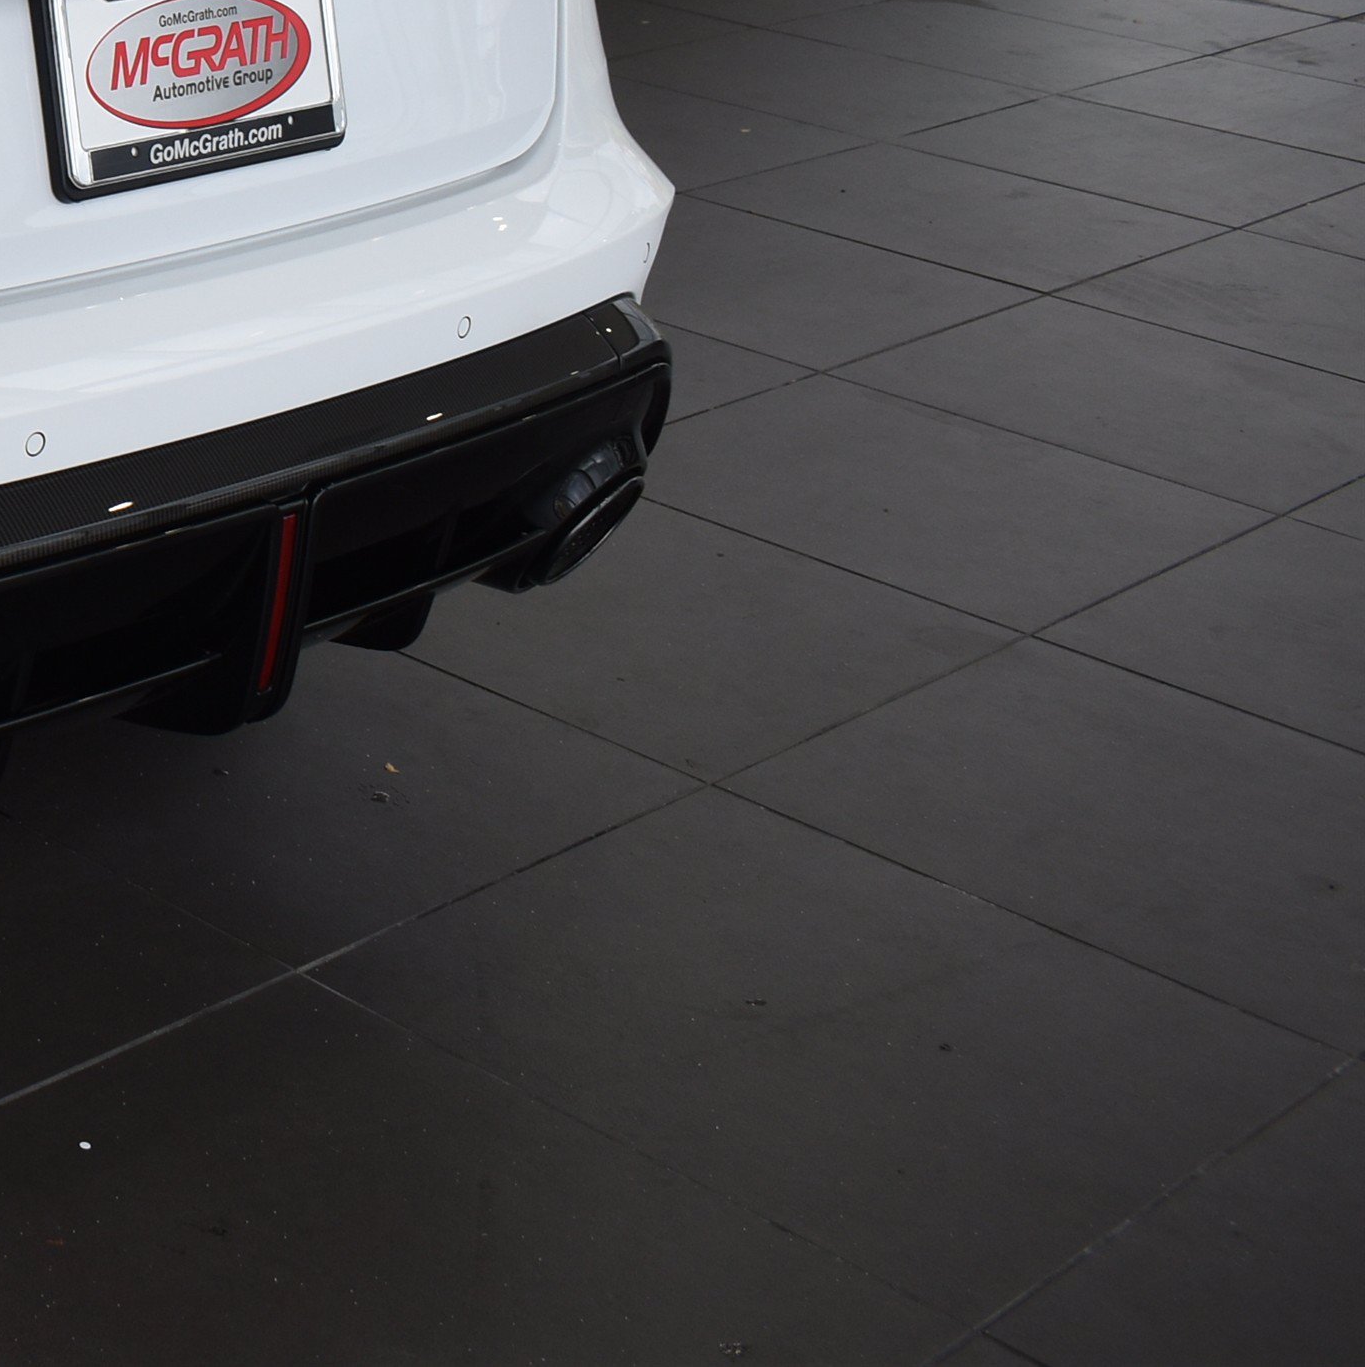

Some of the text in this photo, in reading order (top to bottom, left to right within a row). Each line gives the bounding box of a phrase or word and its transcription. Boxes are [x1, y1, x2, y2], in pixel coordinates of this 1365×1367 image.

[158, 5, 237, 27] GoMcGrath.com
[110, 15, 292, 91] McGRATH
[152, 68, 273, 102] Automotive Group
[149, 122, 283, 165] GoMcGrath.com
